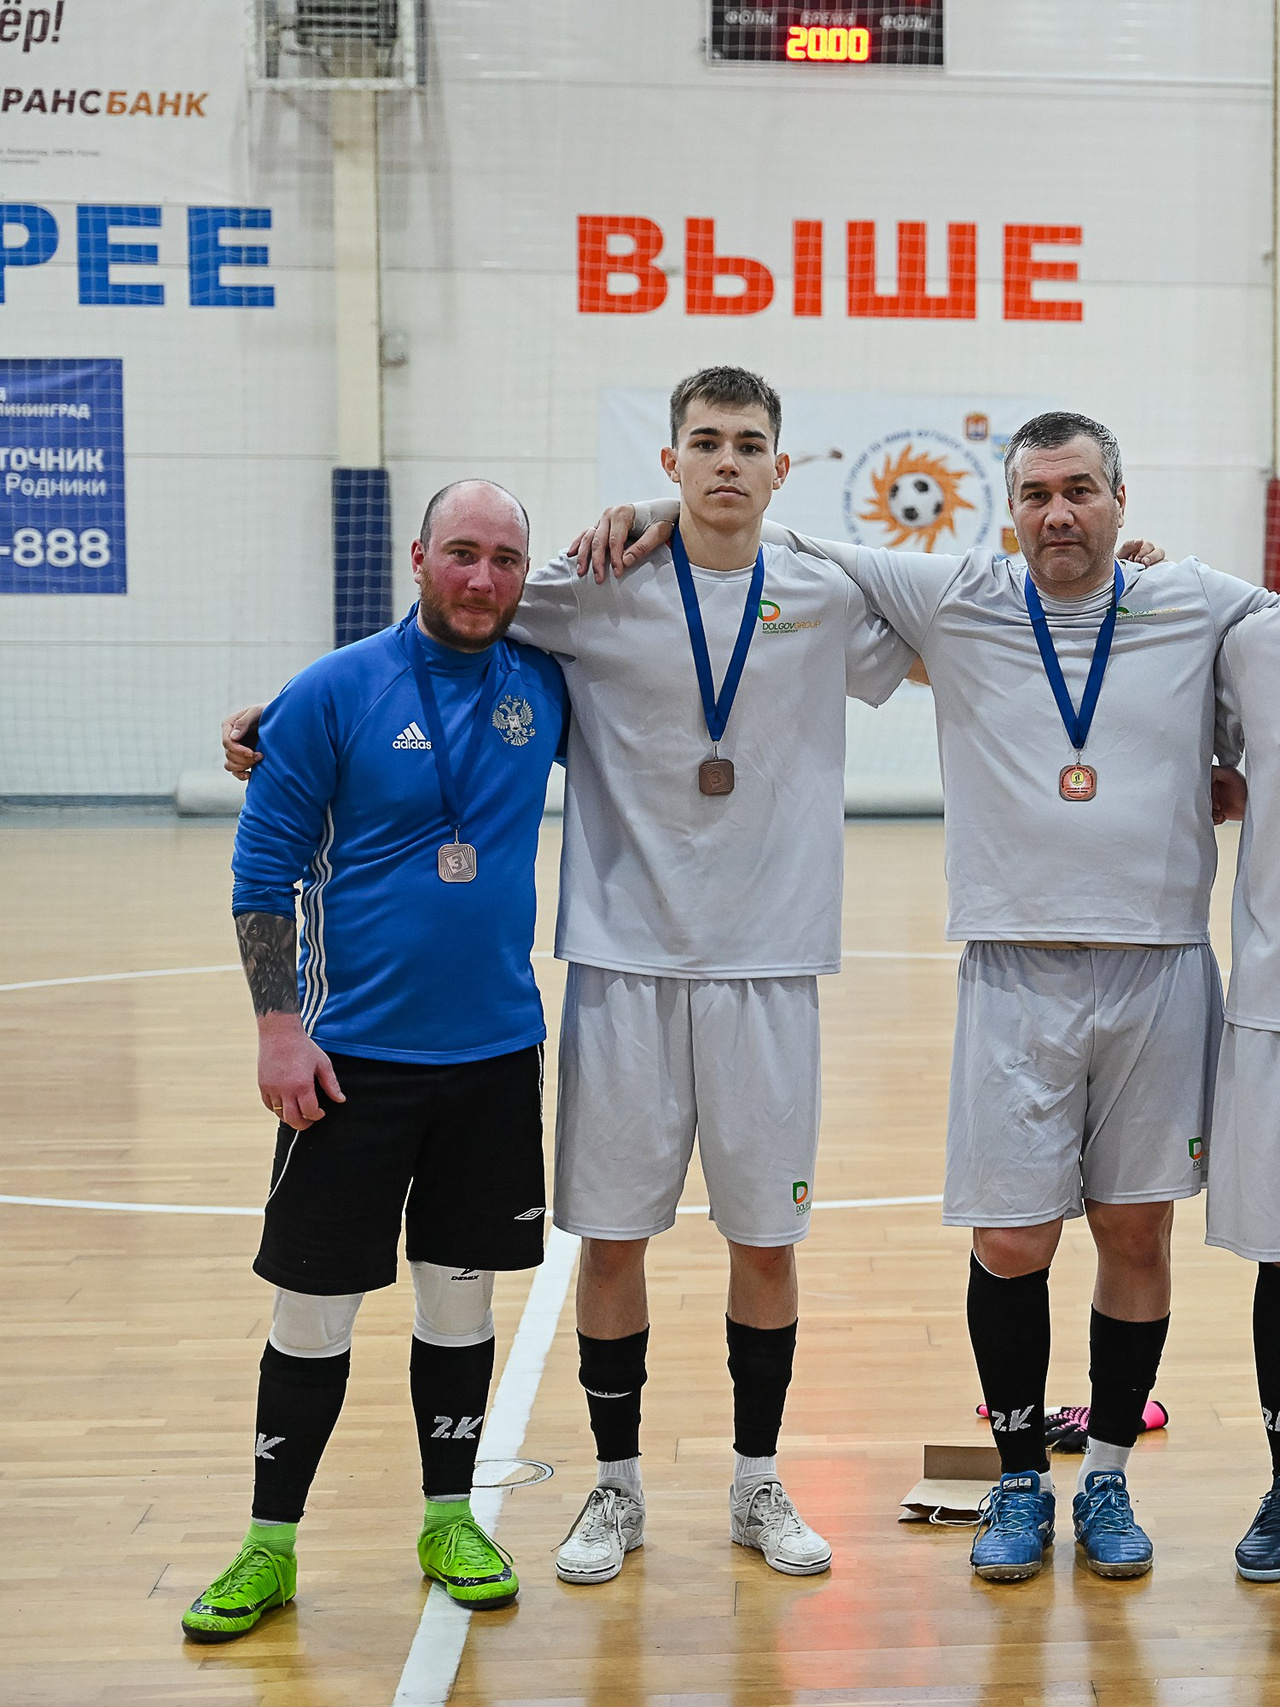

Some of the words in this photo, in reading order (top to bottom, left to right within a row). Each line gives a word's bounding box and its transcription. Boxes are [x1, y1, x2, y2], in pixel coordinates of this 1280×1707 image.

[1, 87, 210, 118] РАНСБАНК
[0, 203, 275, 308] РЕЕ
[577, 214, 1084, 322] ВЫШЕ
[5, 472, 107, 499] Родники
[392, 738, 432, 750] adidas
[451, 855, 463, 871] 3
[430, 1415, 483, 1438] 2K
[992, 1404, 1035, 1432] 2K
